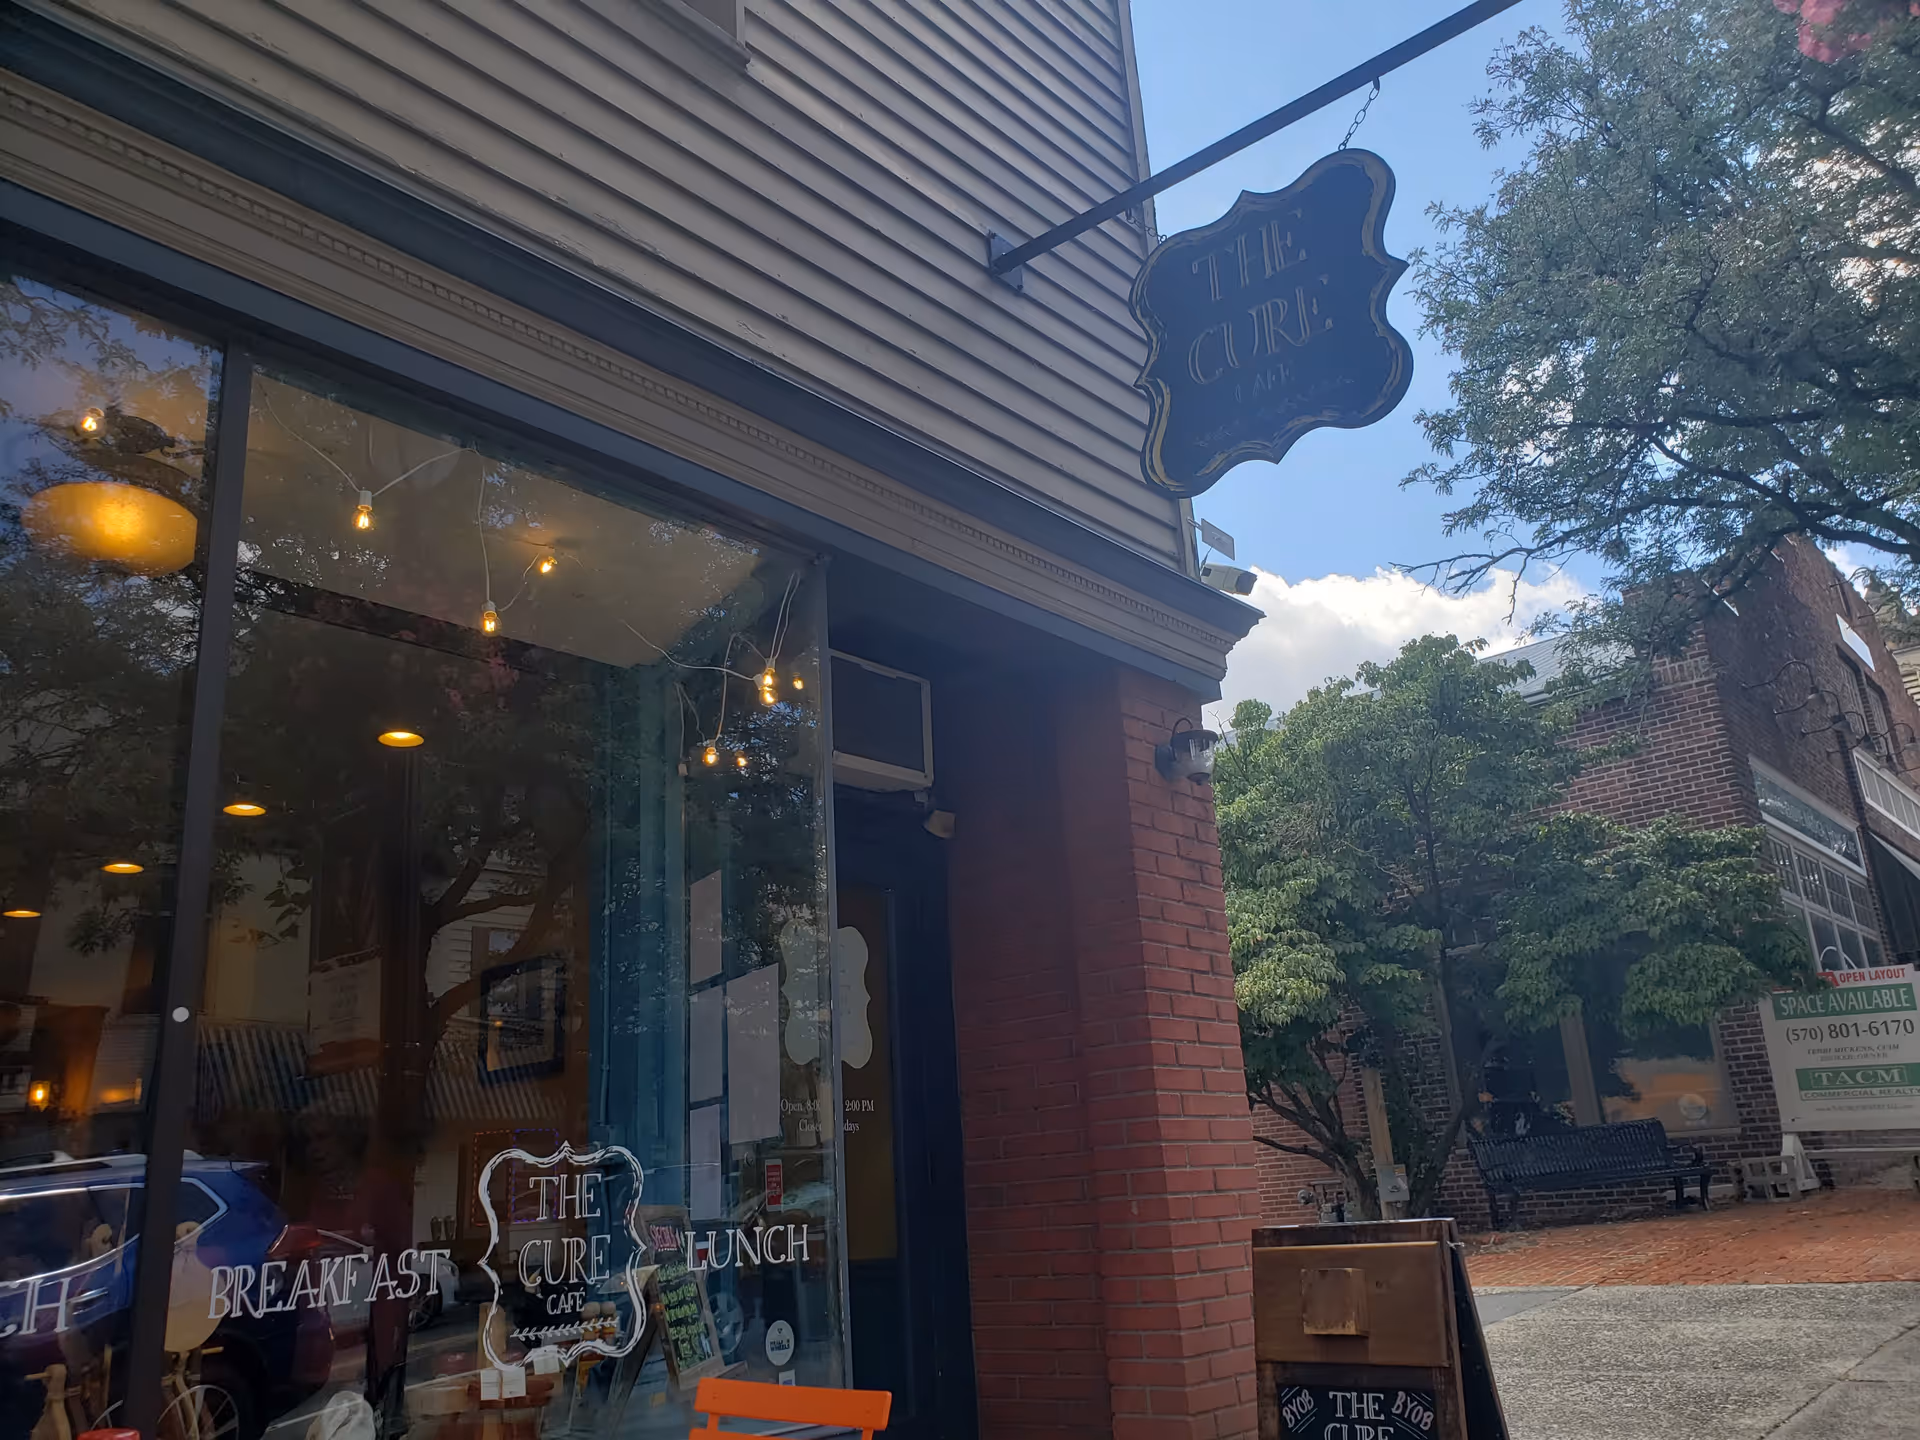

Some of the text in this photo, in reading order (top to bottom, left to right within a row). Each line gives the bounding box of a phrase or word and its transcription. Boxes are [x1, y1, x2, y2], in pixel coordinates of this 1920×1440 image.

[1191, 208, 1308, 301] THE
[1188, 273, 1334, 385] CURE
[1838, 967, 1906, 984] OPEN LAYOUT
[1780, 988, 1911, 1016] SPACE AVAILABLE
[1786, 1018, 1915, 1045] (570) 801-6170
[1803, 1088, 1878, 1099] COMMERCIAL
[1814, 1068, 1903, 1087] TACM
[780, 1098, 803, 1115] Open
[845, 1099, 860, 1112] 2:00
[861, 1099, 875, 1112] PM
[529, 1173, 602, 1222] THE
[518, 1234, 611, 1288] CURE
[684, 1224, 810, 1272] LUNCH
[207, 1248, 451, 1319] BREAKFAST
[1282, 1388, 1315, 1429] BYOB
[1328, 1390, 1385, 1421] THE
[1391, 1390, 1435, 1431] BYOB
